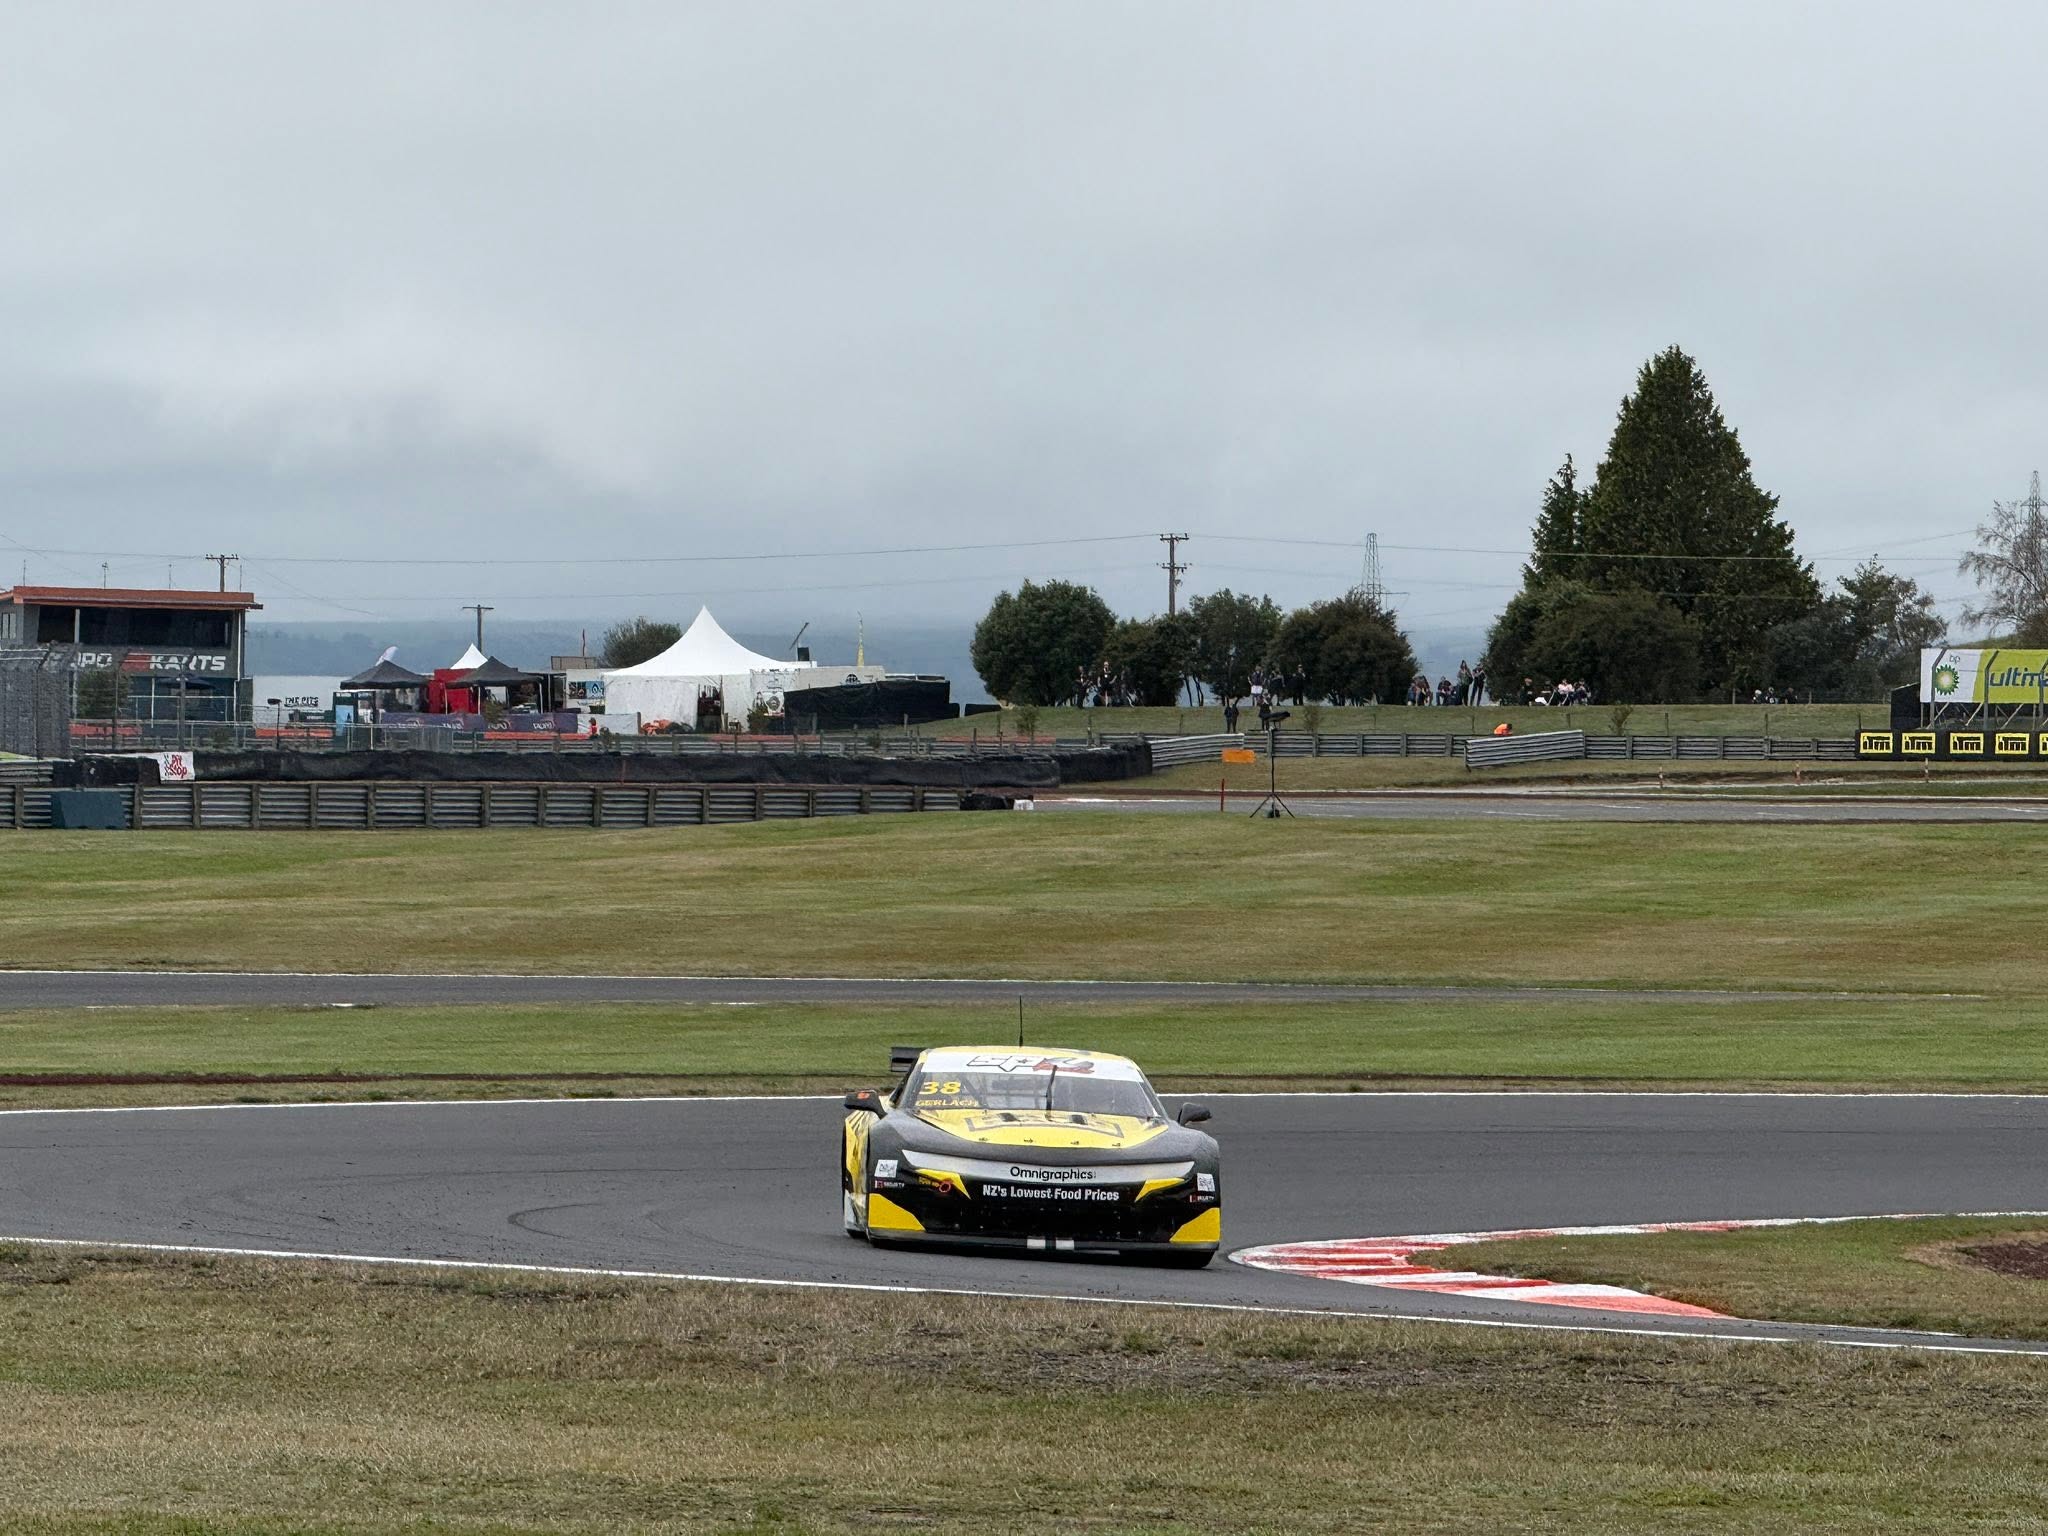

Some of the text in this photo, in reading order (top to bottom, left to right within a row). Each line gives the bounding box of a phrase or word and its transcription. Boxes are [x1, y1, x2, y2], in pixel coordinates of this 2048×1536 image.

[1950, 655, 1961, 664] bp
[918, 1081, 962, 1095] 38
[1010, 1166, 1093, 1181] Omnigraphics
[983, 1184, 1120, 1201] NZ's Lowest Food Prices
